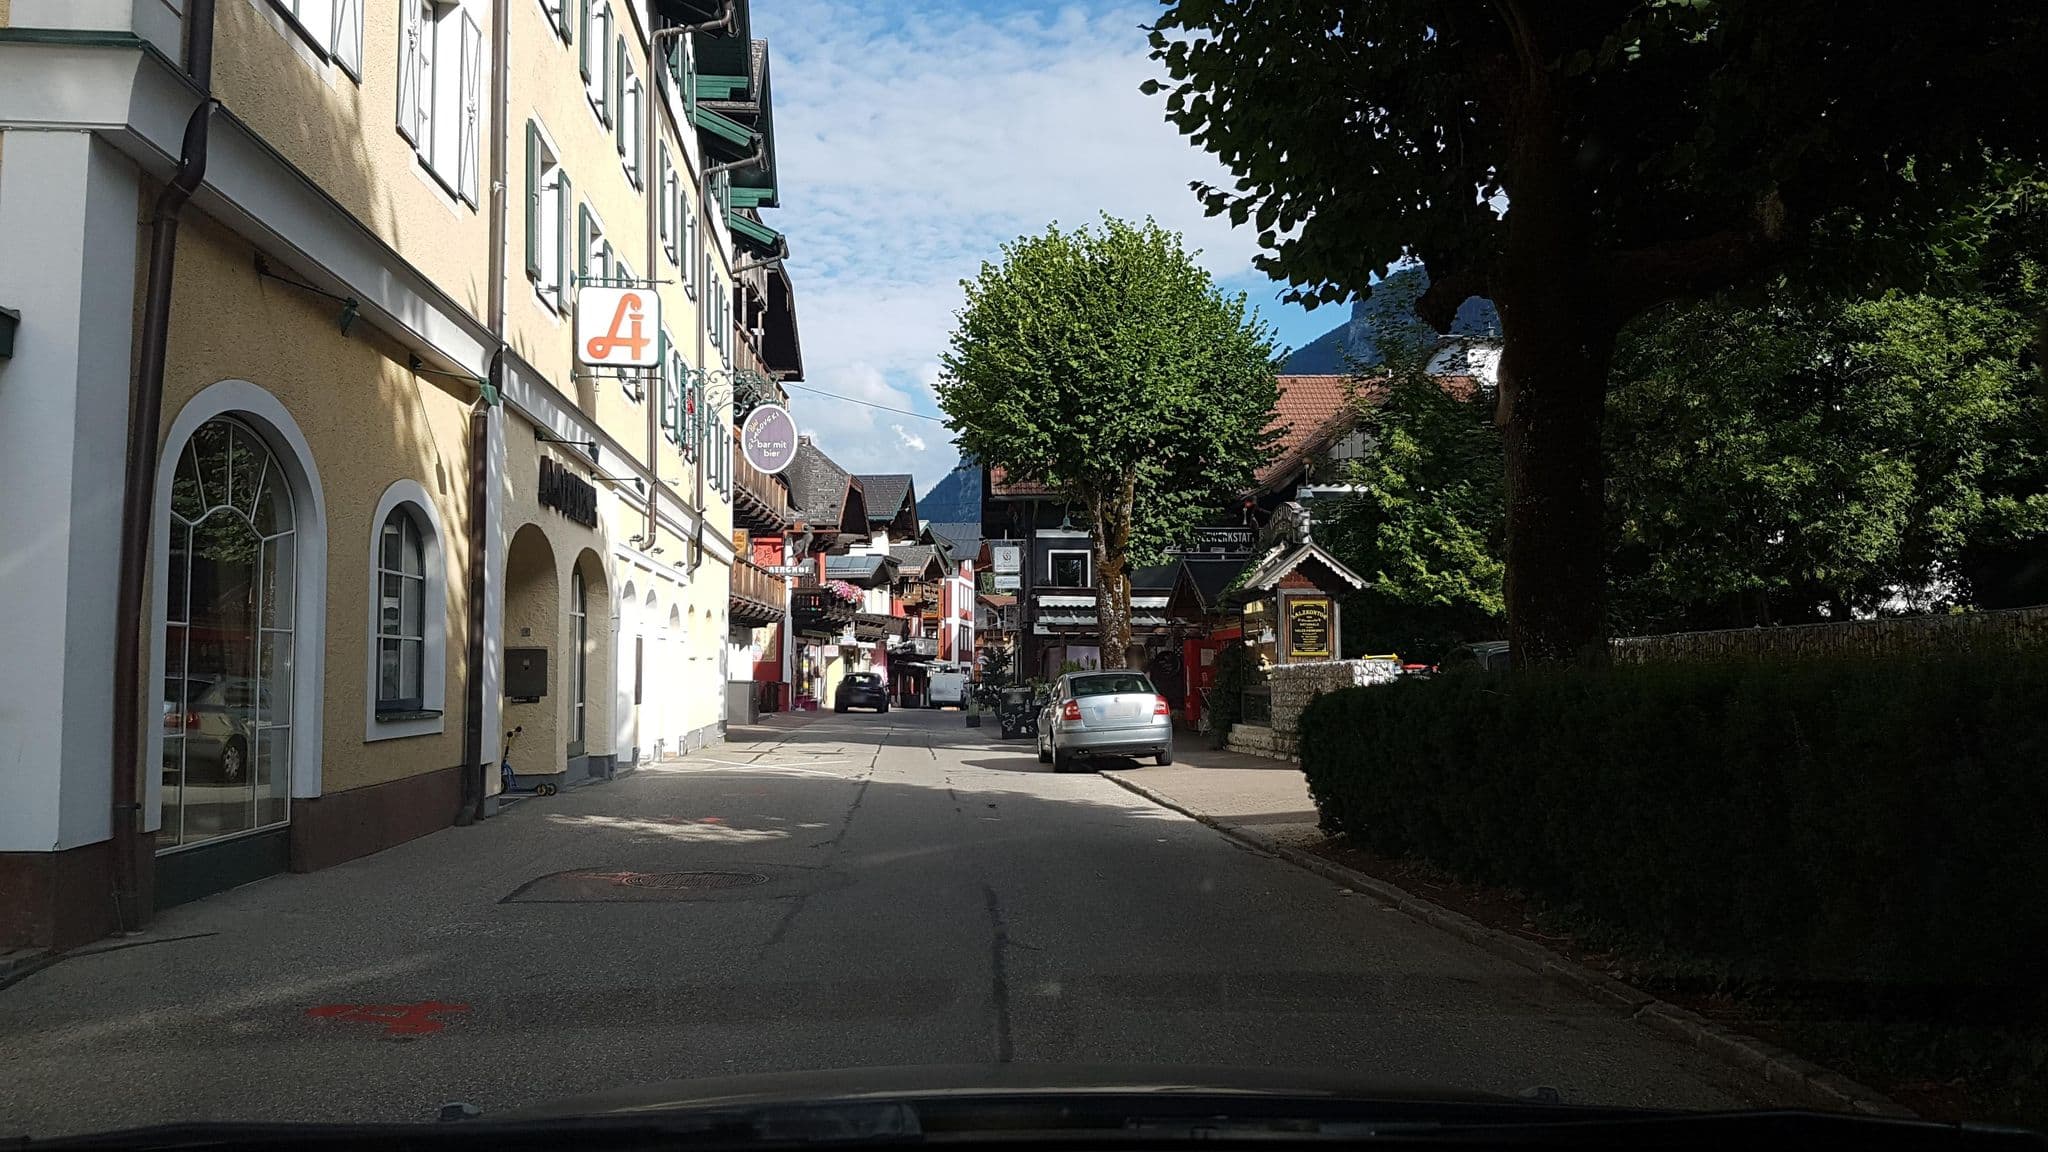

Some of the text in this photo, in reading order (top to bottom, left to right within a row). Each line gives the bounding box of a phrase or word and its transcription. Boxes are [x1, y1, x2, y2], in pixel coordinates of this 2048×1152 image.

[757, 440, 787, 449] bar mit
[763, 449, 780, 457] bier
